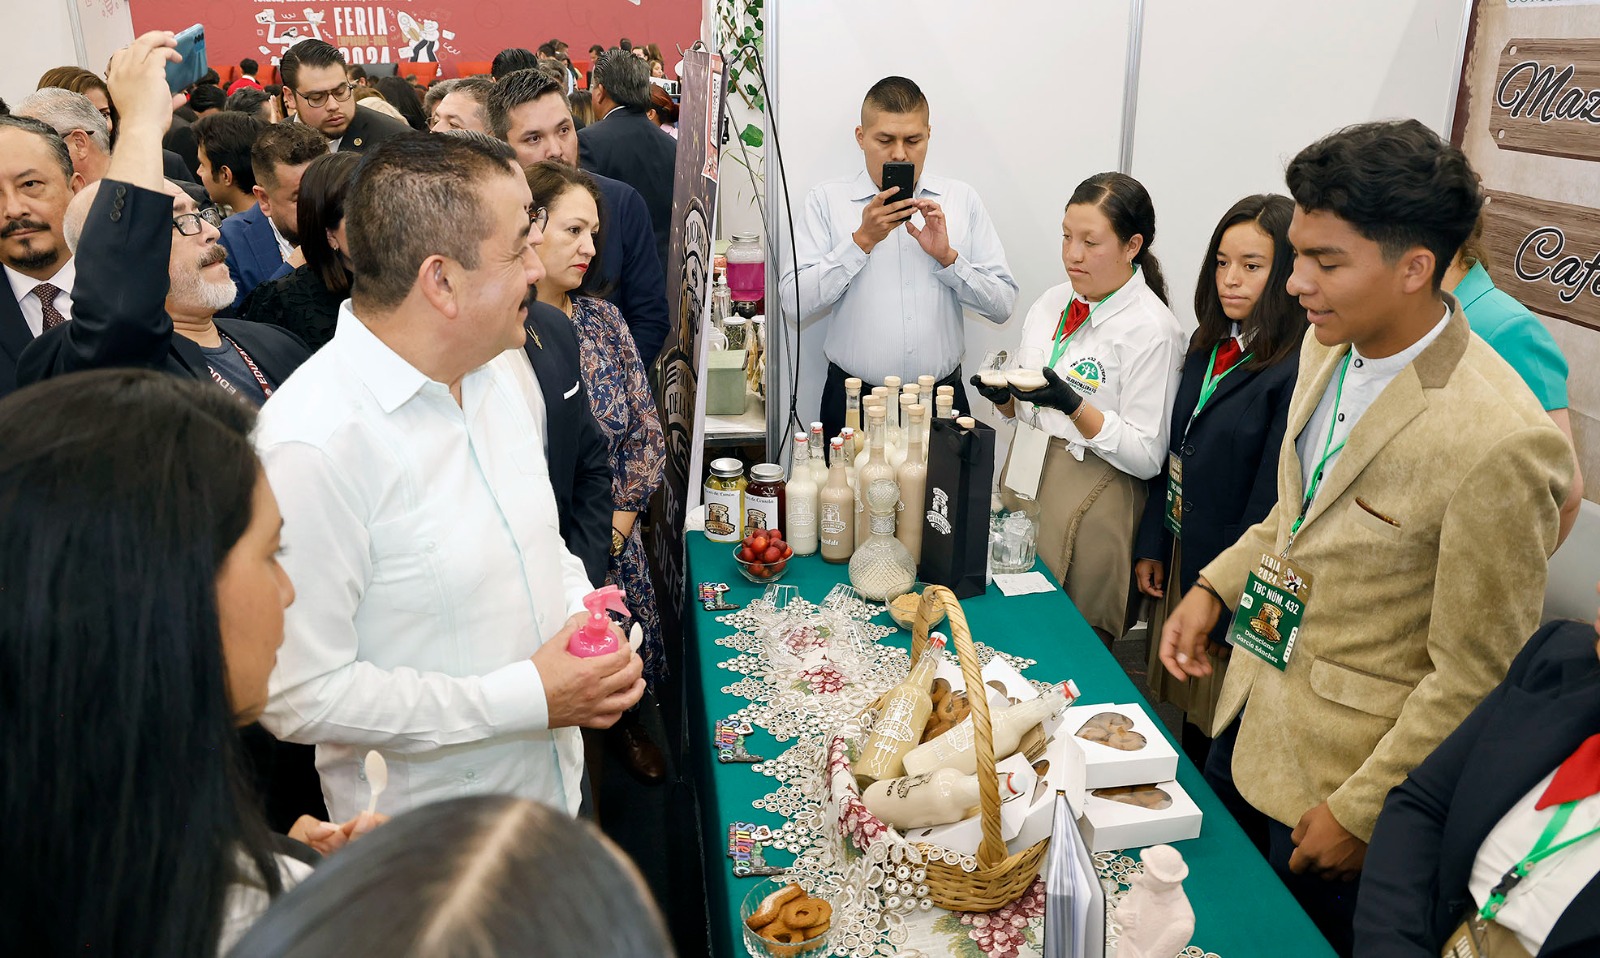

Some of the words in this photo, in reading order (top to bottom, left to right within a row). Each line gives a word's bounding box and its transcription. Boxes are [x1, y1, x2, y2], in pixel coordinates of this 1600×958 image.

[334, 7, 388, 36] FERIA
[1514, 226, 1600, 303] Caf
[662, 473, 680, 540] TBC
[1257, 567, 1279, 585] 2024
[1261, 553, 1281, 573] FERIA
[1253, 580, 1267, 596] TBC
[1266, 588, 1284, 607] NÚM.
[1285, 600, 1300, 616] 432
[1244, 630, 1275, 652] Donaciano
[1254, 645, 1279, 664] Sánchez
[729, 822, 757, 875] Sultepec
